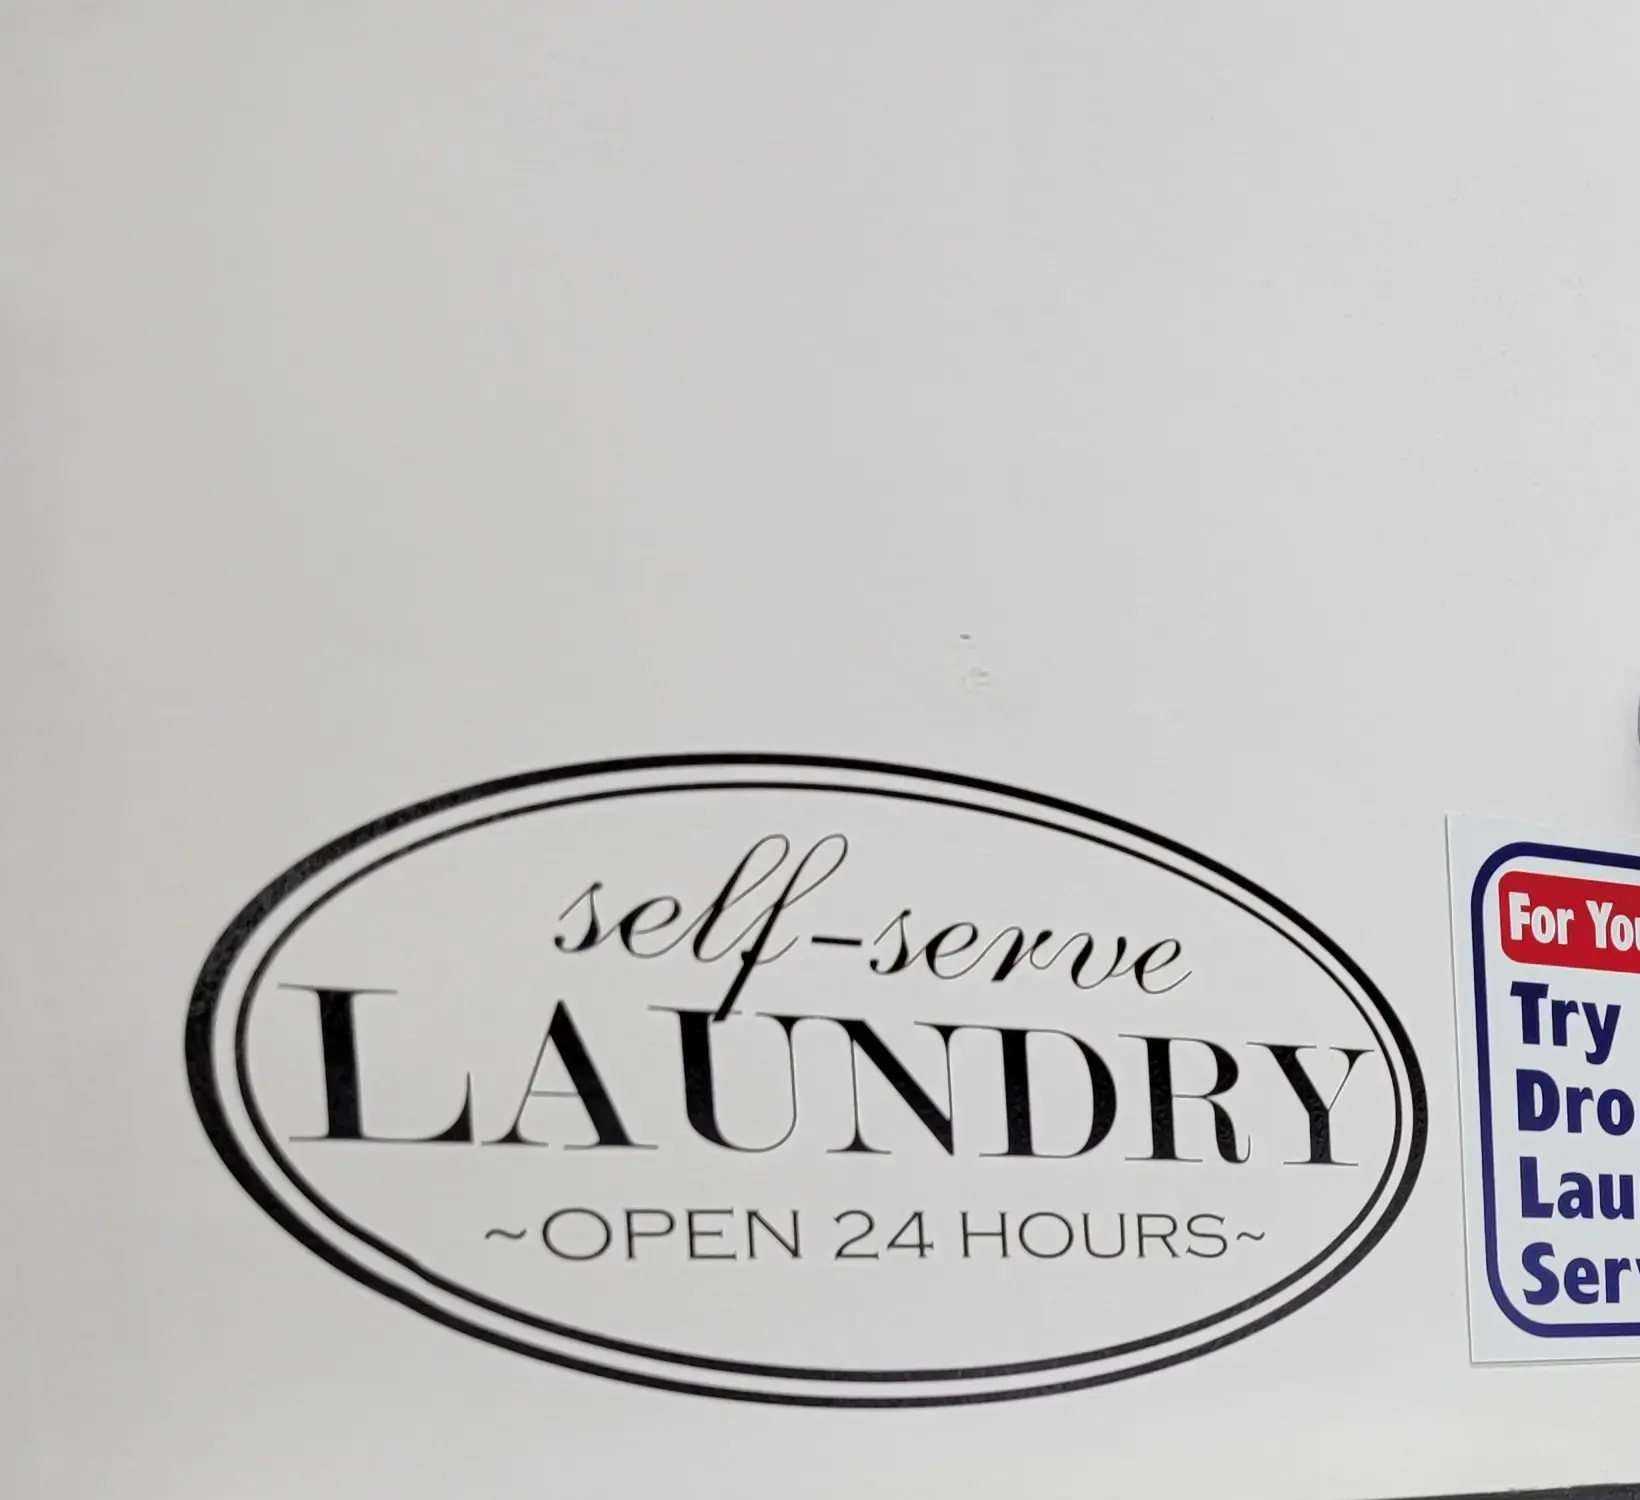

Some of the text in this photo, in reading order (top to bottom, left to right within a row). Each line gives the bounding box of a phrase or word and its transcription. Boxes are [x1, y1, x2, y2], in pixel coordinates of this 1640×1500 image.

[554, 834, 1193, 1023] self-serve
[1508, 892, 1575, 947] For
[1509, 982, 1622, 1065] Try
[276, 983, 1376, 1167] LAUNDRY
[833, 1211, 935, 1261] 24
